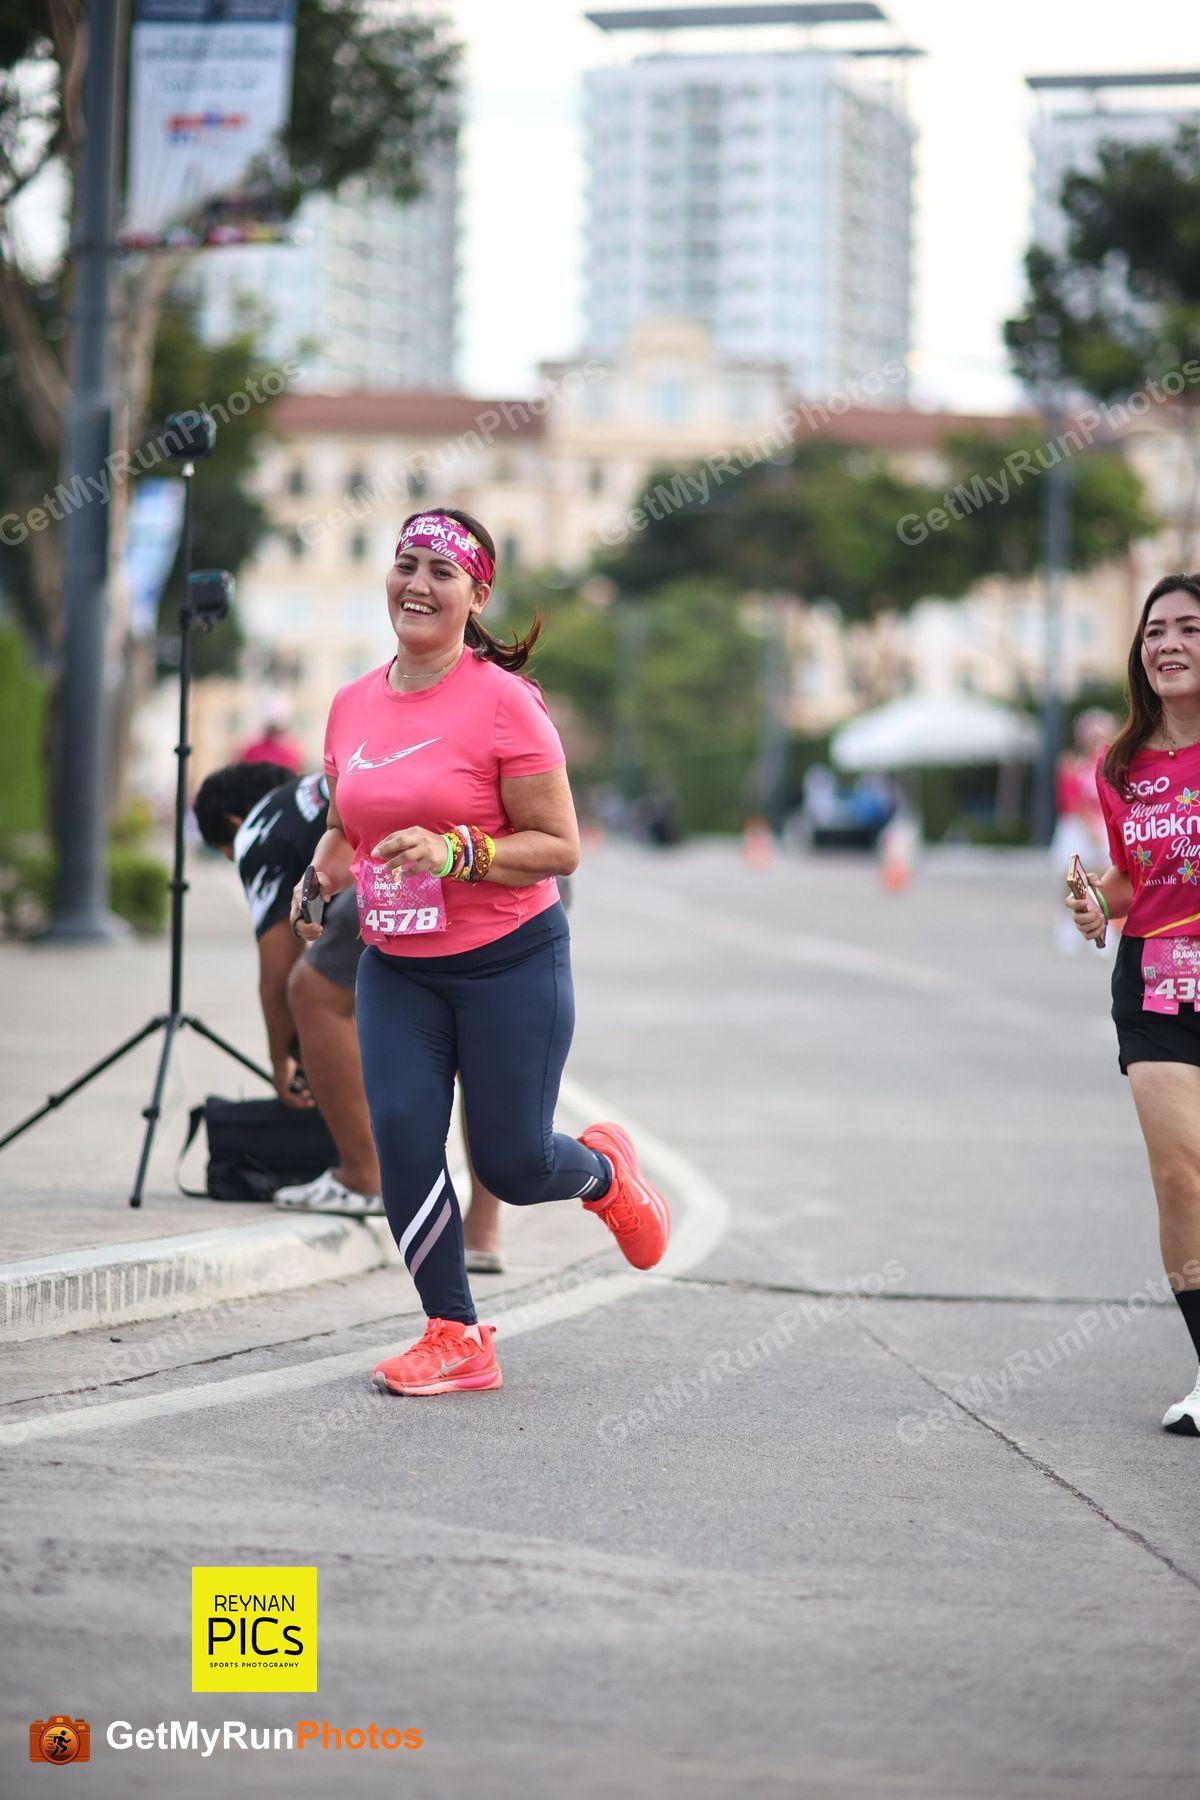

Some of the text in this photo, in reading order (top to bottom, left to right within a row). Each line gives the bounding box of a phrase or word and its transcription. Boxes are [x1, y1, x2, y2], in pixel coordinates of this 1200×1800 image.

[431, 538, 457, 560] Run
[1126, 801, 1171, 822] Reyna
[1166, 836, 1200, 860] Ru
[1162, 875, 1177, 885] Life
[365, 907, 439, 932] 4578
[1155, 978, 1200, 1000] 43
